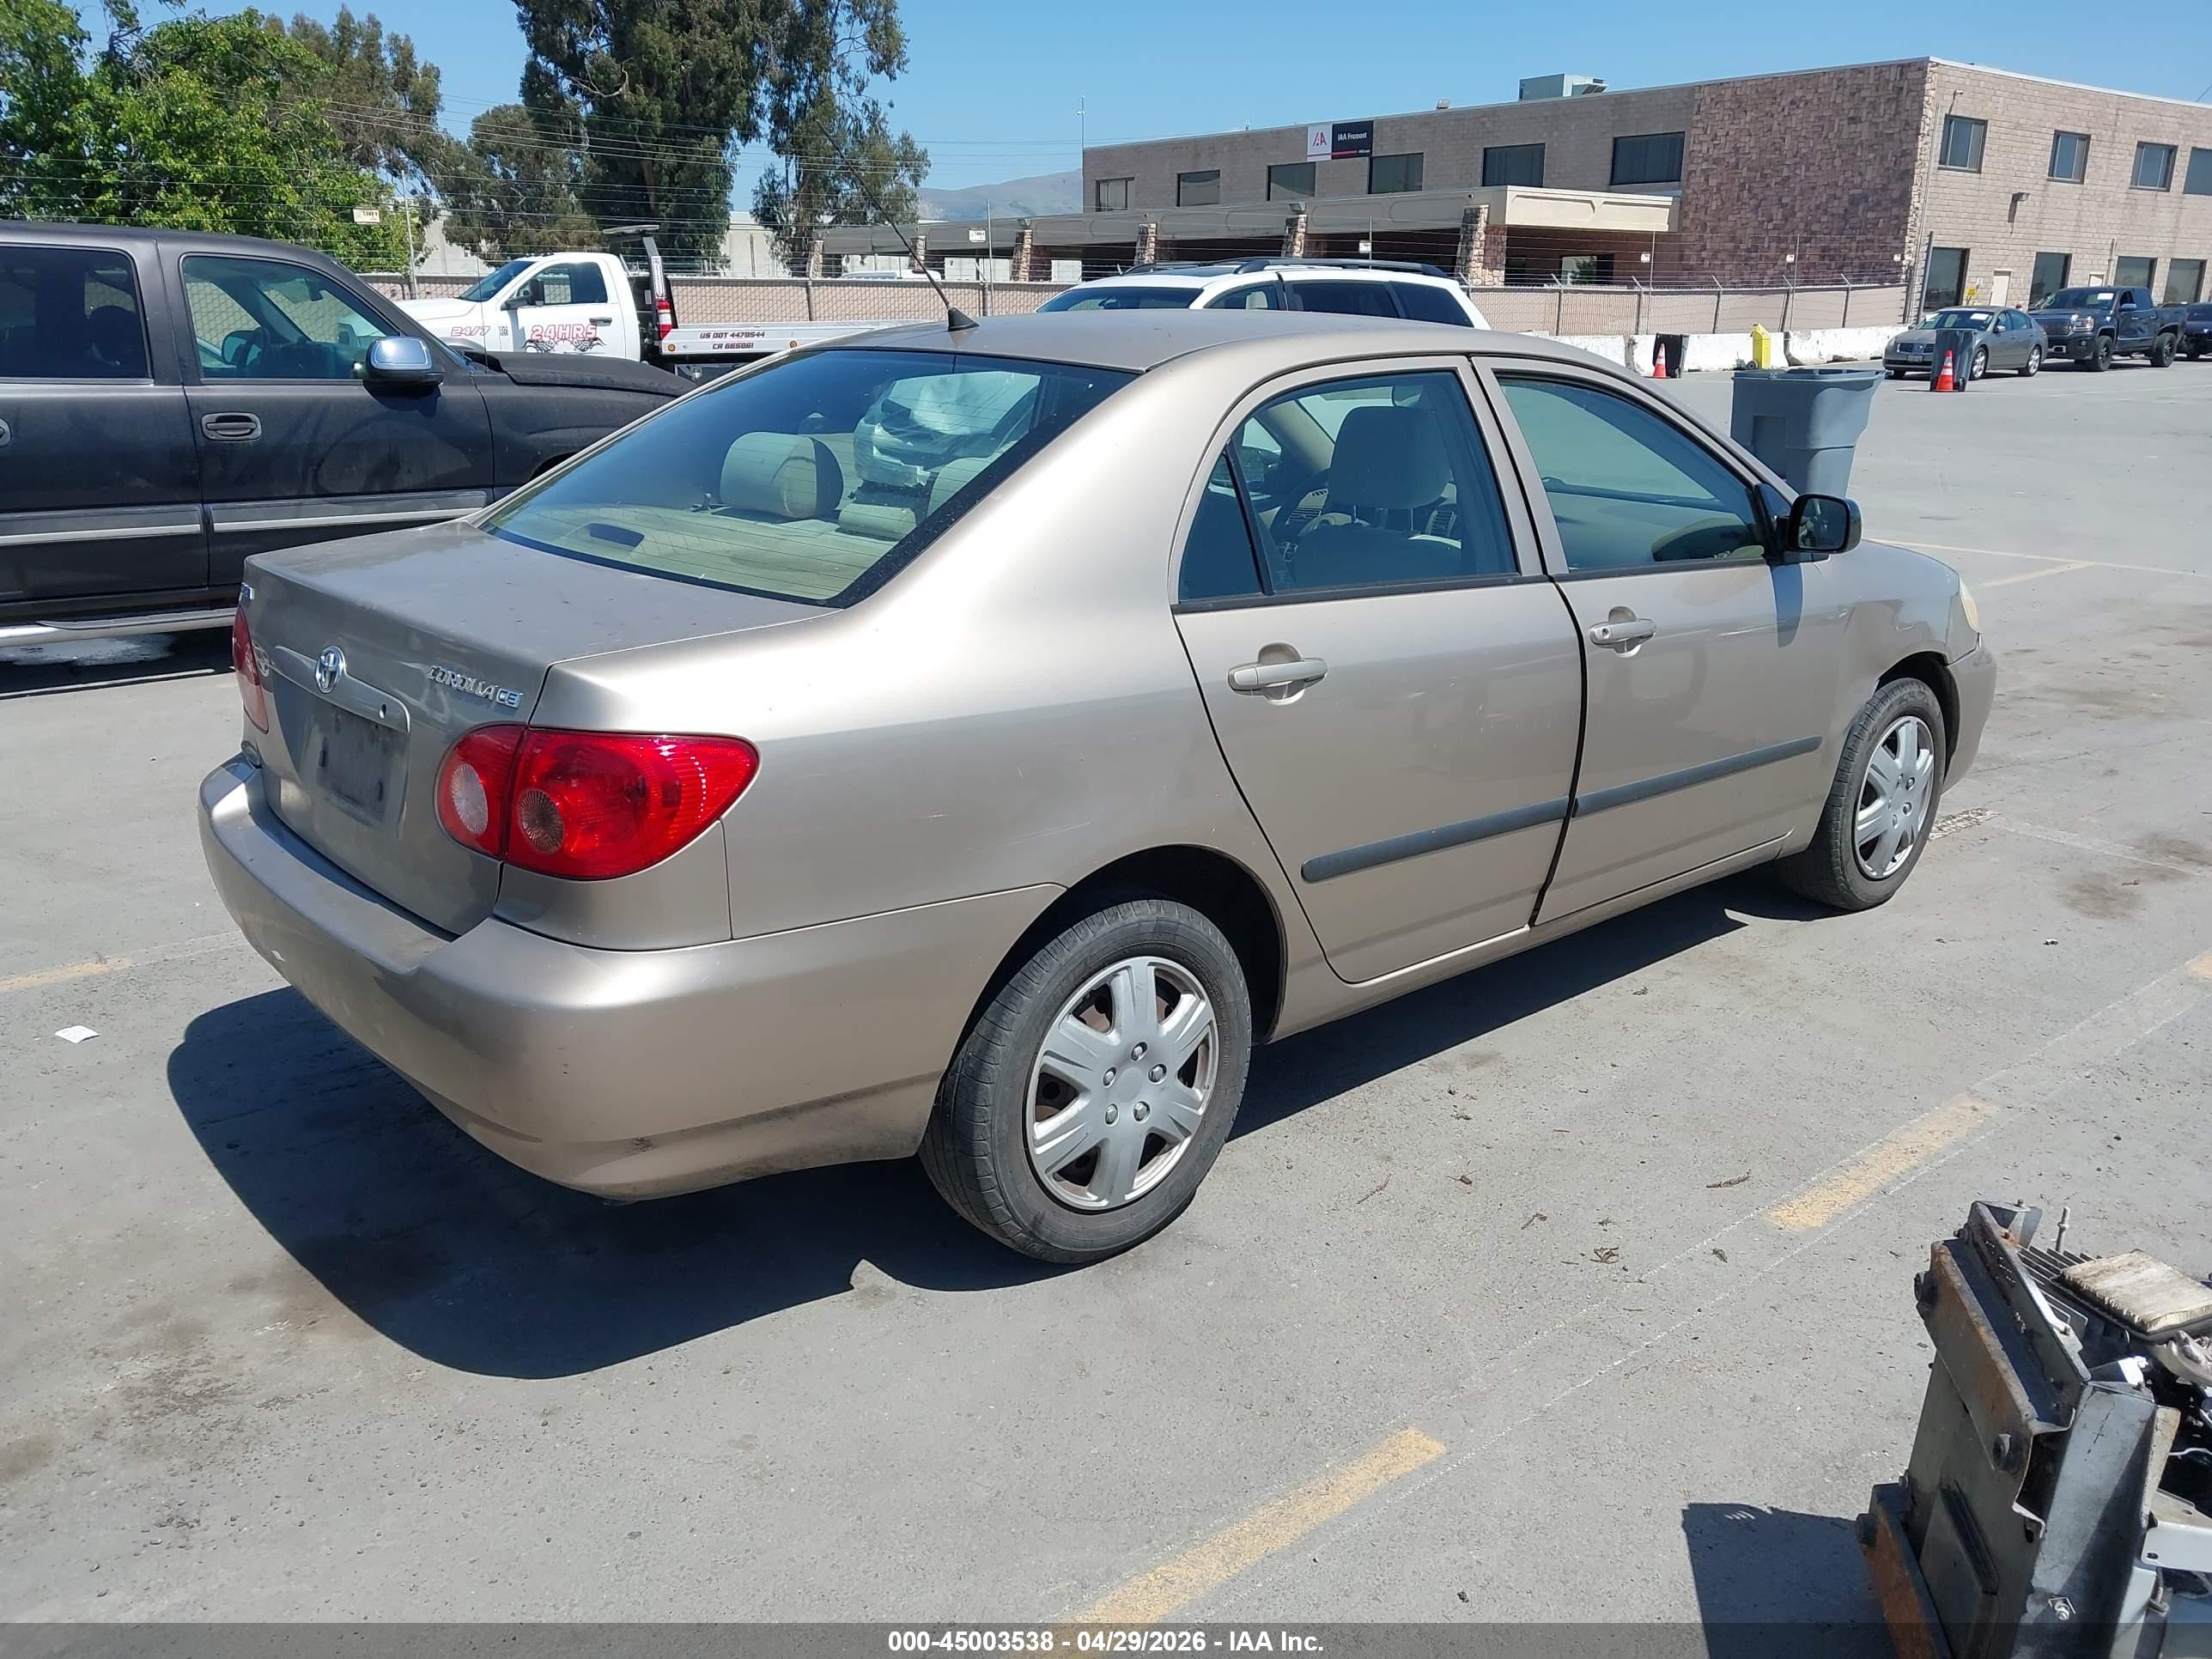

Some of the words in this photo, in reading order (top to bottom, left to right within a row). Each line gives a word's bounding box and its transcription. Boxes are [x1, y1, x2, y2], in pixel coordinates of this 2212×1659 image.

[1337, 132, 1346, 142] IAA
[1347, 131, 1367, 140] Fremont
[451, 326, 491, 337] 24/7
[531, 324, 598, 342] 24HRS
[495, 687, 524, 708] CE
